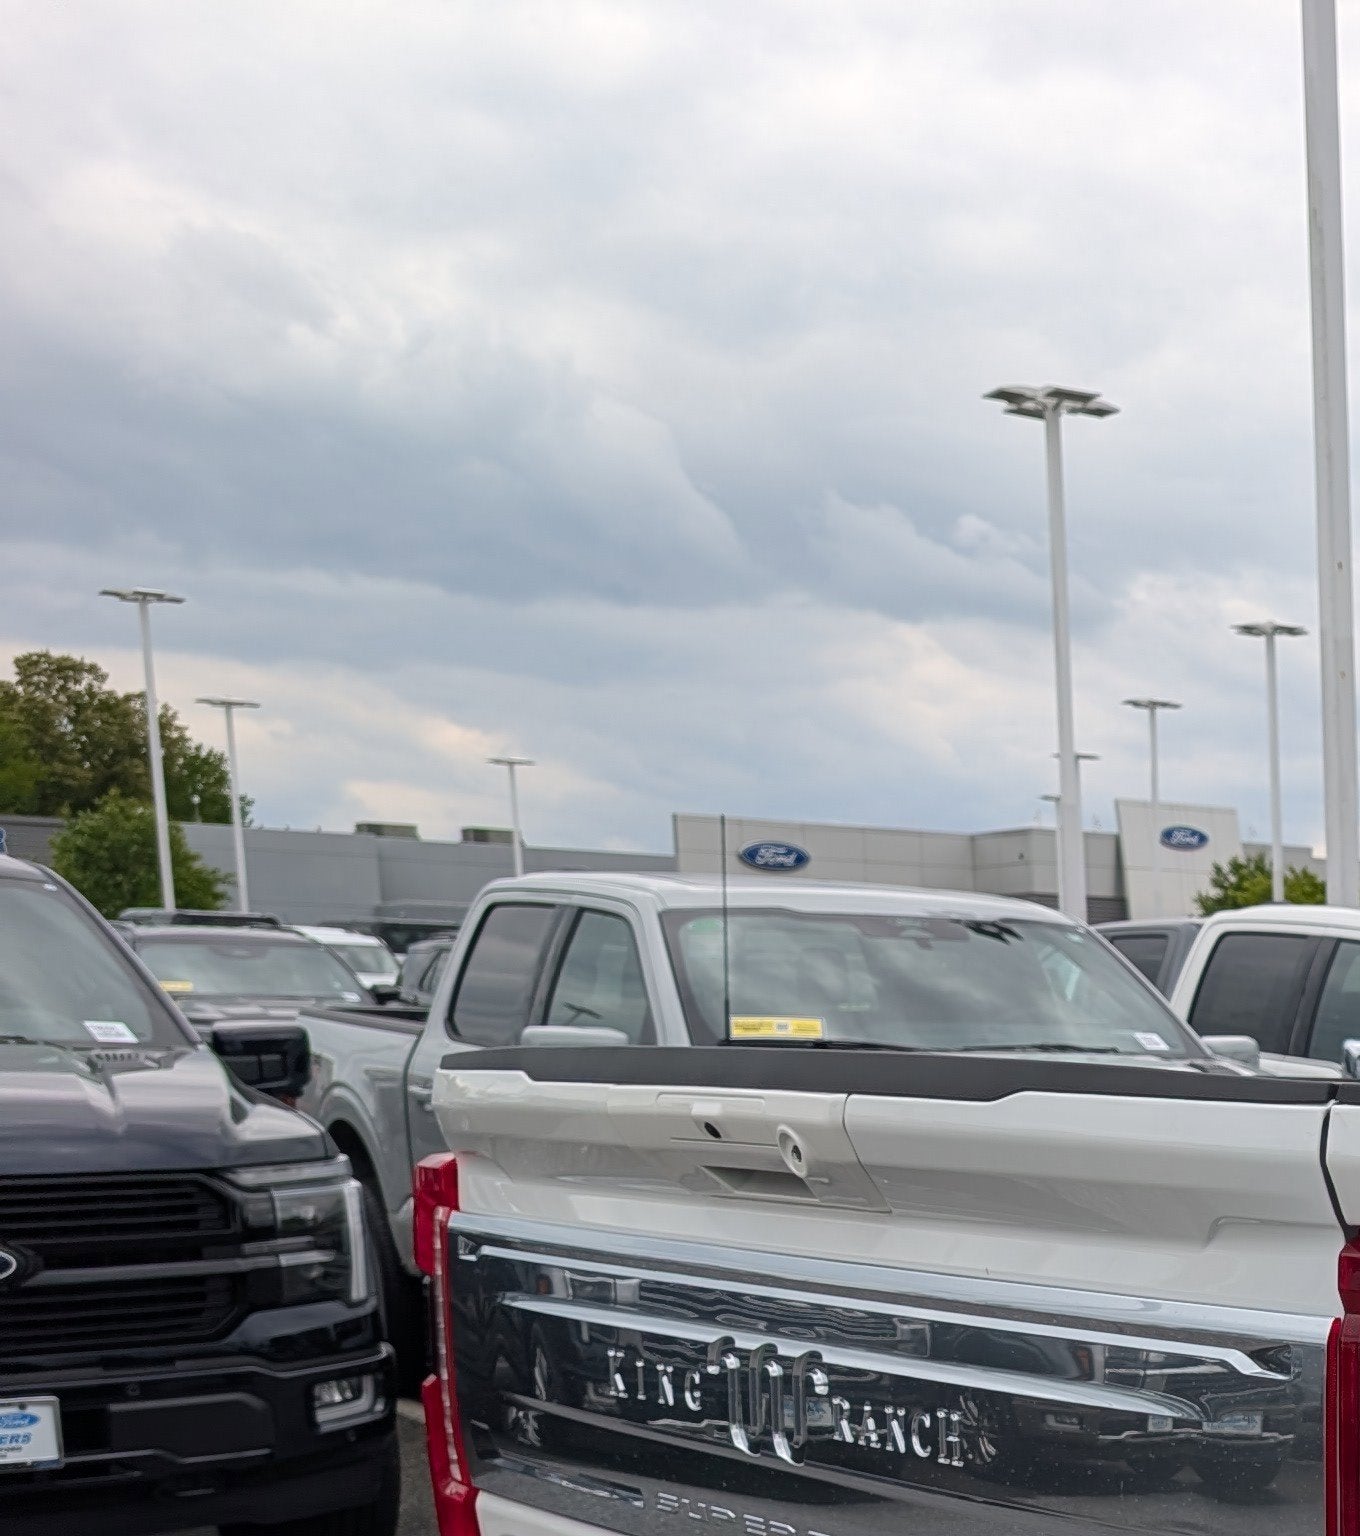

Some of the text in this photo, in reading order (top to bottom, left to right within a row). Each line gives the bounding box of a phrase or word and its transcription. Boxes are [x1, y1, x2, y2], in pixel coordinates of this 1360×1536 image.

[1169, 829, 1200, 844] Ford
[755, 844, 799, 867] Ford
[606, 1348, 702, 1411] KING
[832, 1396, 965, 1467] RANCH
